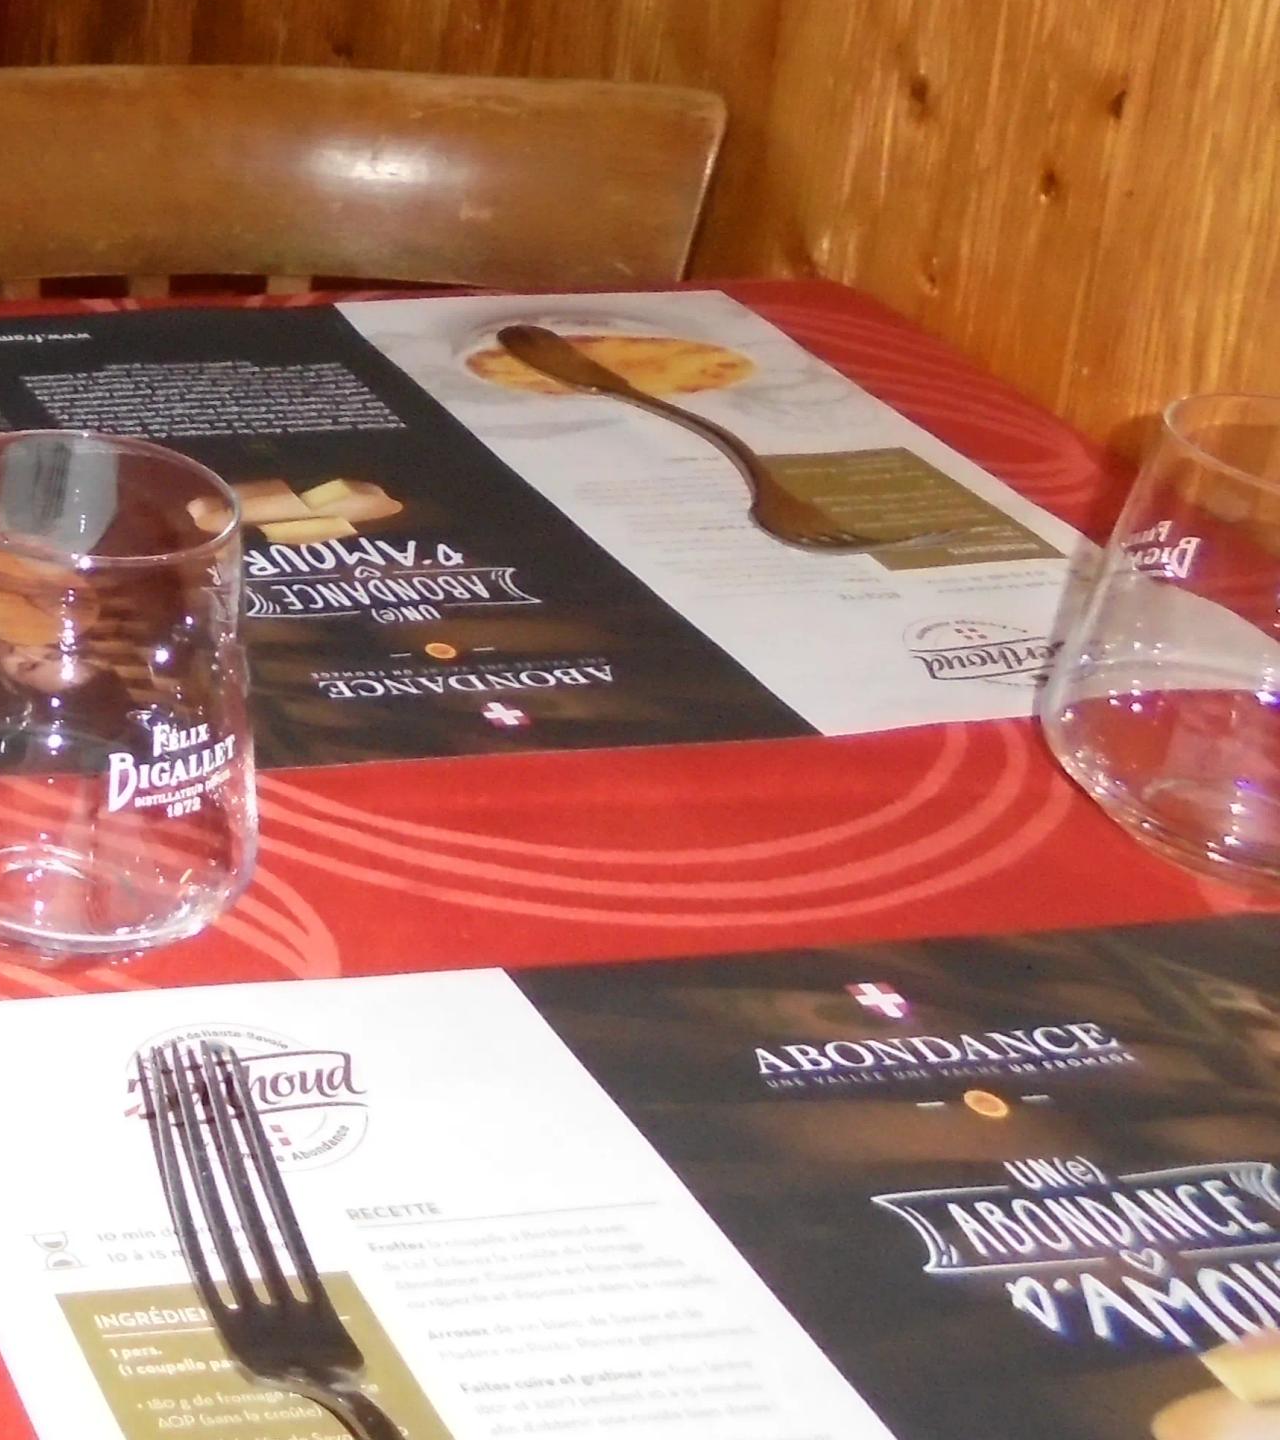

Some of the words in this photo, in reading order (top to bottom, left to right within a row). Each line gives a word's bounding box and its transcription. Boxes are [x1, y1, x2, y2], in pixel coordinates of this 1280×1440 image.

[243, 537, 464, 577] D'AMOUR
[271, 574, 490, 610] ABONDANCE
[372, 603, 440, 623] UN(e)
[916, 643, 1060, 679] erthoud
[318, 665, 614, 699] ABONDANCE
[108, 734, 236, 813] BIGALLET
[166, 796, 202, 818] 1872
[754, 1022, 1119, 1075] ABONDANCE
[1003, 1155, 1107, 1191] UN(e)
[347, 1200, 442, 1221] RECETTE
[947, 1179, 1271, 1257] ABONDANCE
[120, 1229, 156, 1241] min
[107, 1252, 129, 1264] 10
[147, 1249, 167, 1261] 15
[93, 1305, 208, 1329] INGRÉDIE
[120, 1345, 162, 1361] pers.
[134, 1358, 206, 1375] coupelle
[193, 1393, 215, 1407] de
[216, 1390, 284, 1407] fromage
